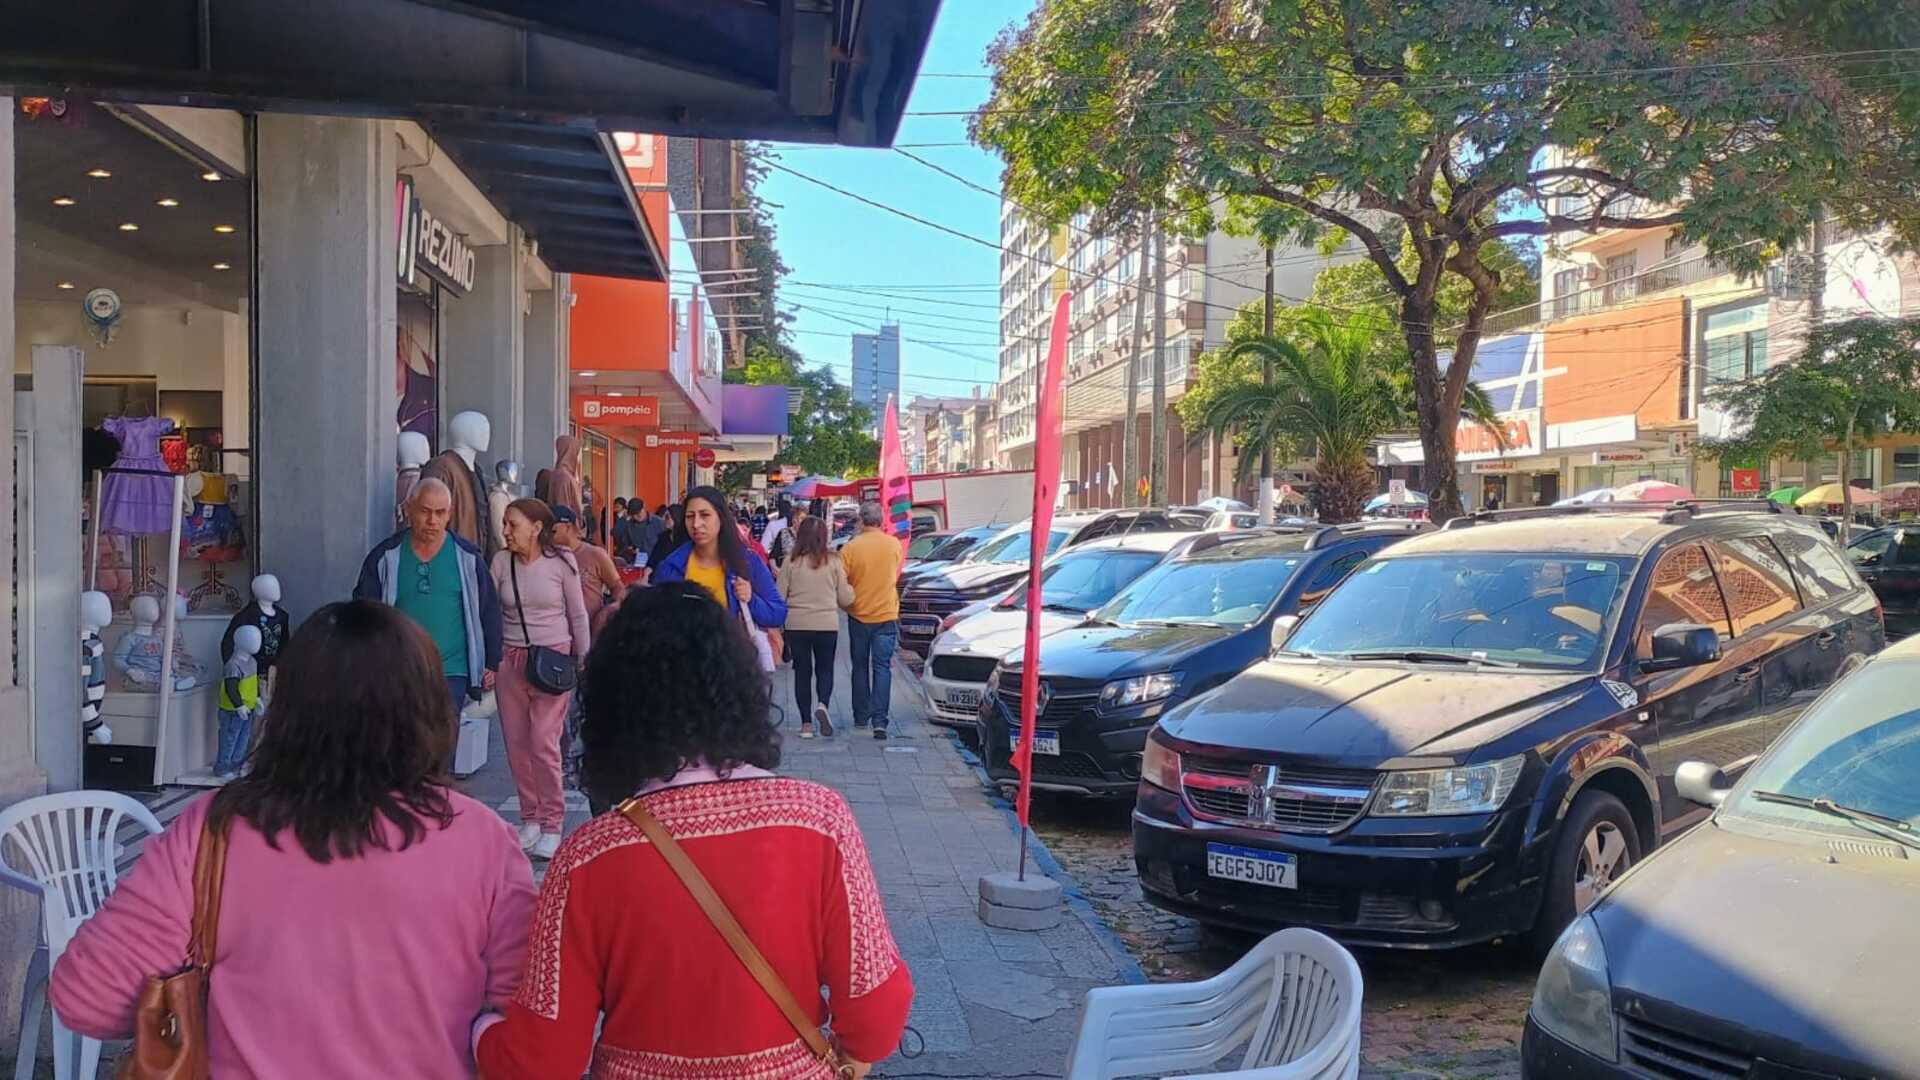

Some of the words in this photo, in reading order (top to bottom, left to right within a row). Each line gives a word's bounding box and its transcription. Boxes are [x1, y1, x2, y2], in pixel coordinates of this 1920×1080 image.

[419, 209, 475, 292] REZUMO
[602, 404, 651, 415] pompéia
[1215, 855, 1285, 884] EGF5J07
